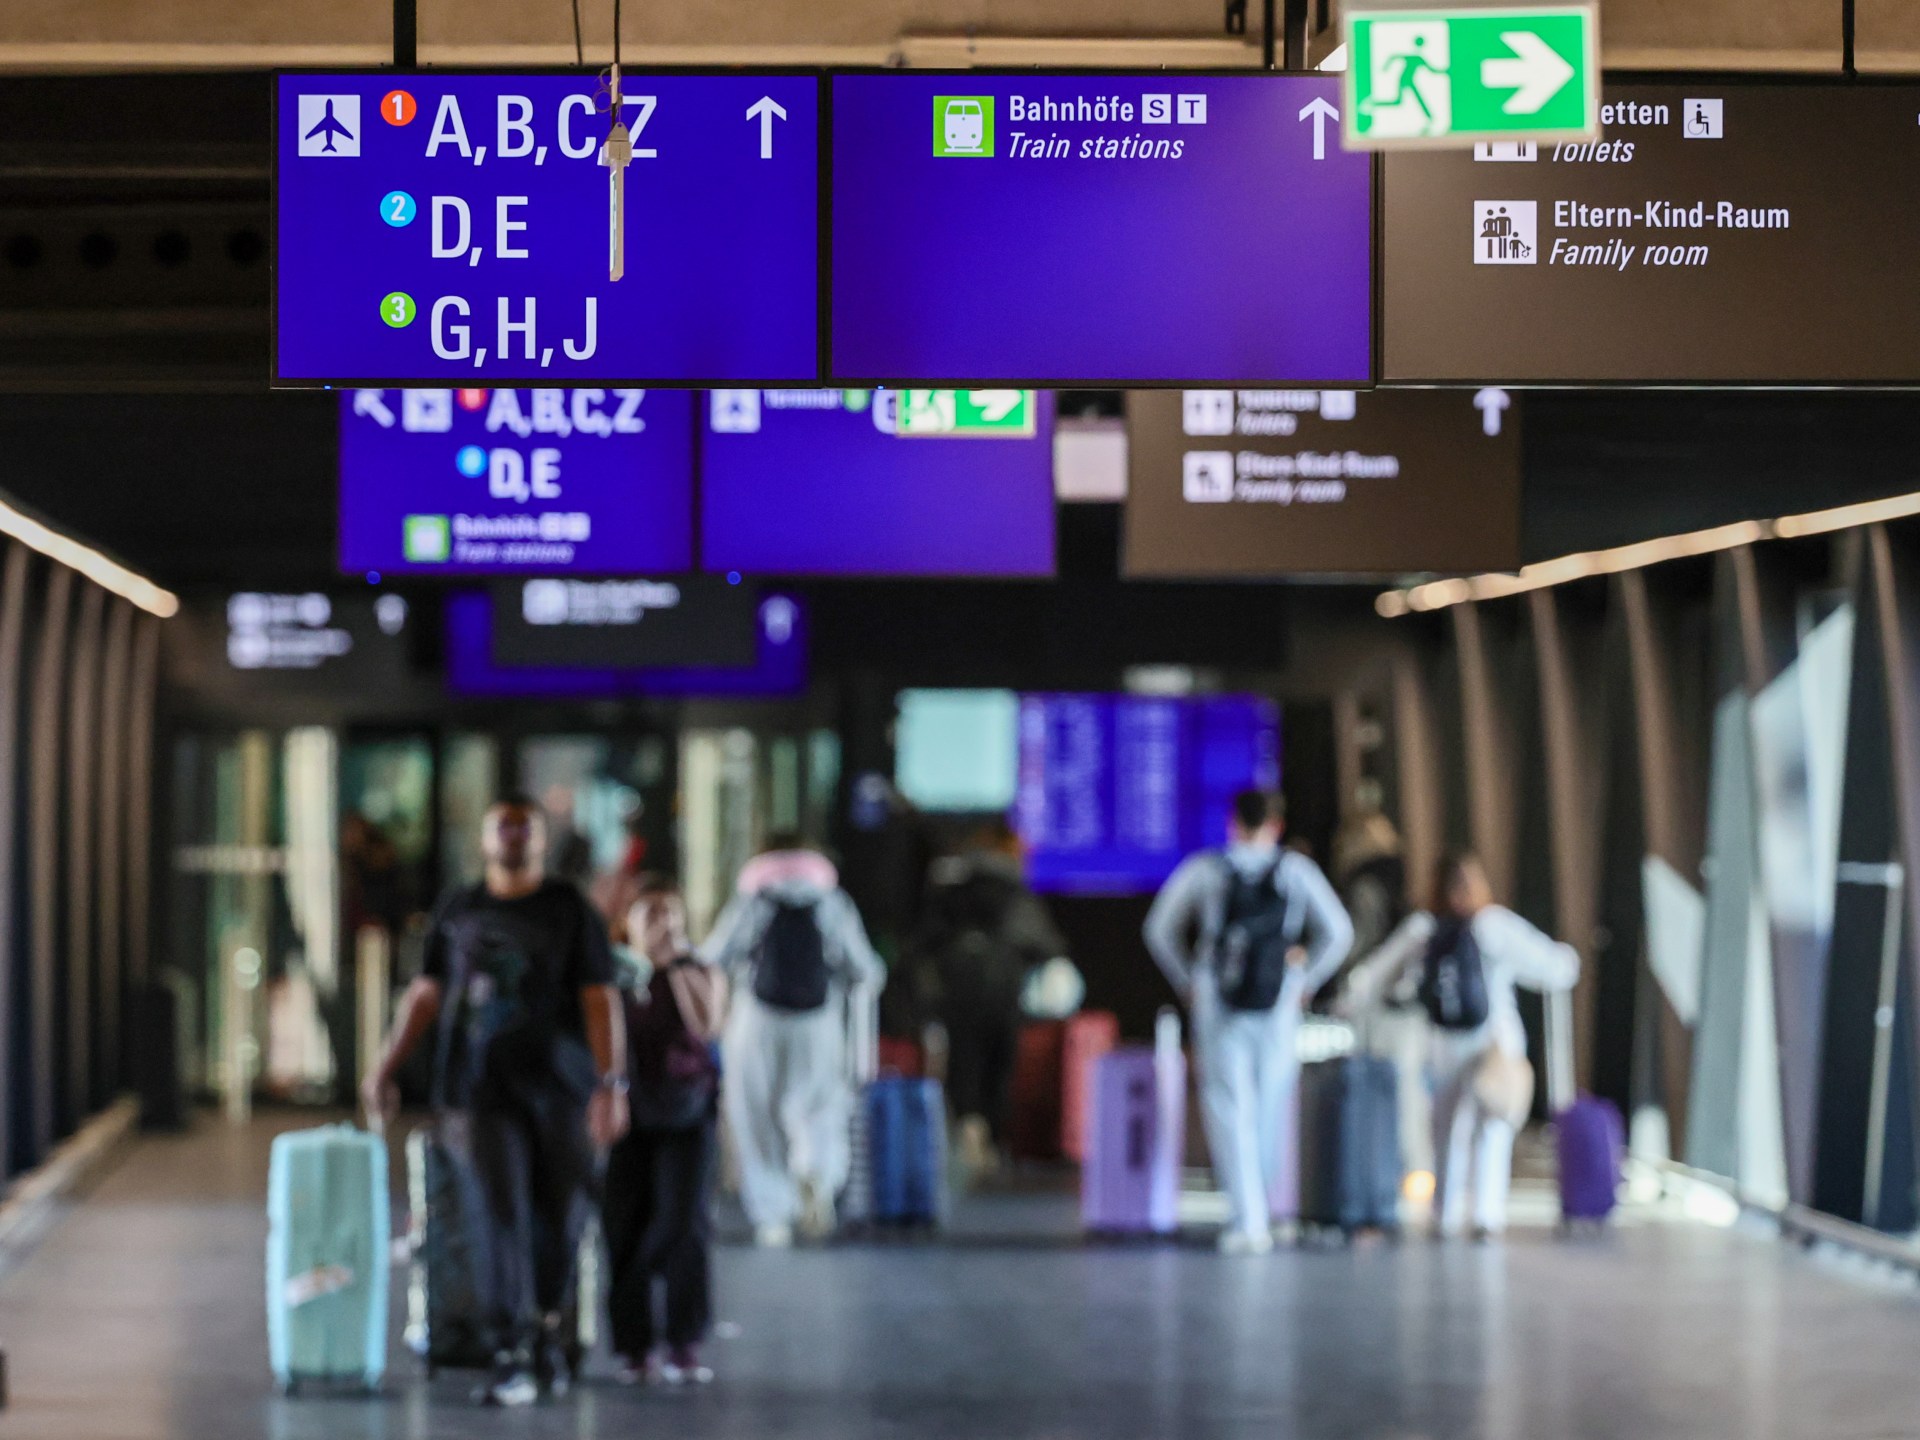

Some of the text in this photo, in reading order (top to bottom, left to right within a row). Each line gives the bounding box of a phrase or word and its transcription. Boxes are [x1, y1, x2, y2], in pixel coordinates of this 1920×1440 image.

[391, 95, 403, 121] 1
[1009, 95, 1134, 122] Bahnhöfe
[1598, 100, 1669, 125] etten
[1009, 133, 1185, 159] Train stations
[1554, 201, 1790, 229] Eltern-Kind-Raum
[390, 195, 529, 266] 2 D,E
[1549, 238, 1709, 272] Family room
[390, 296, 598, 367] 3 G,H,J
